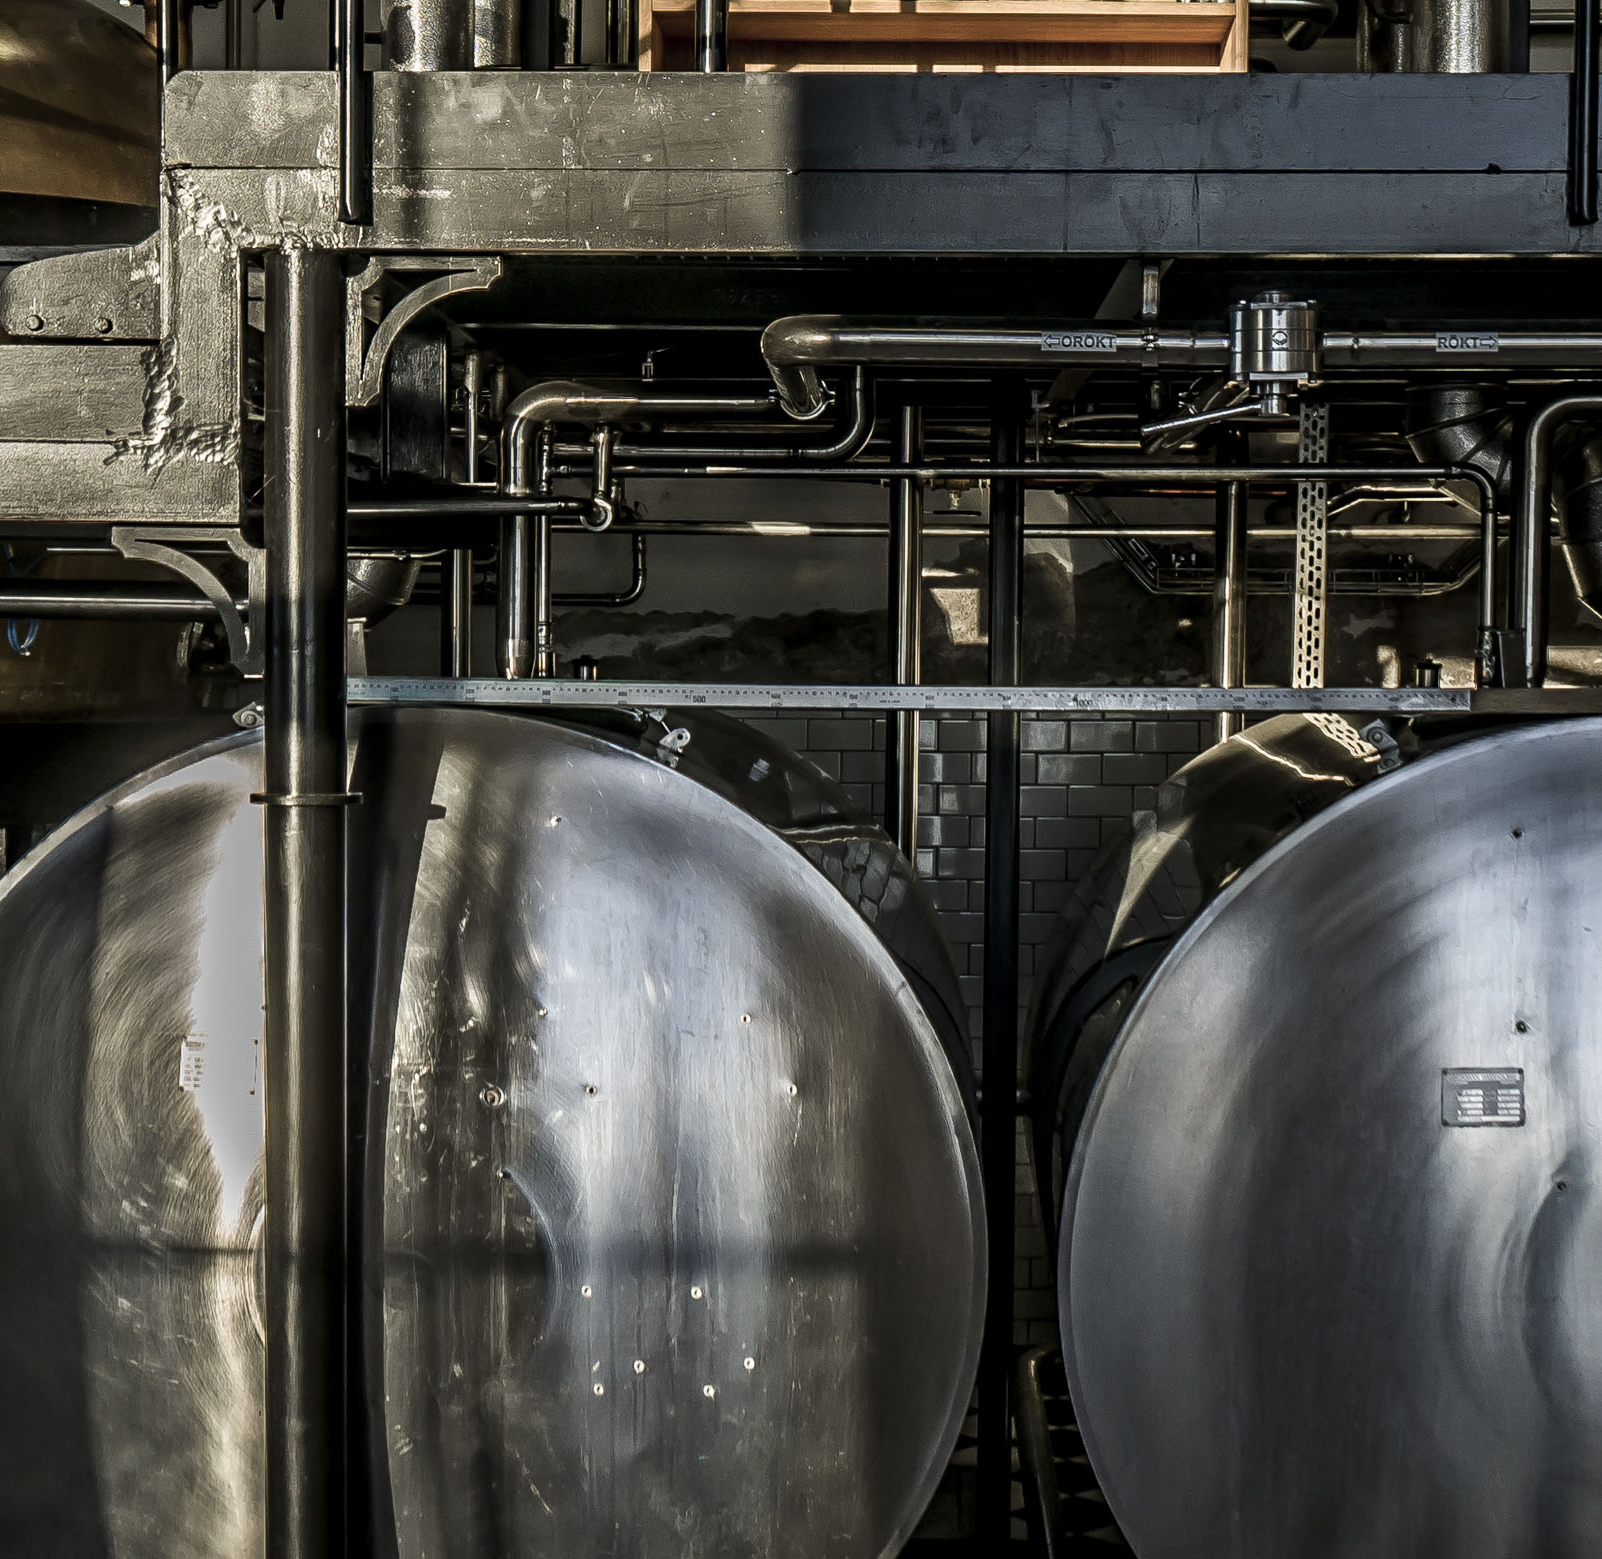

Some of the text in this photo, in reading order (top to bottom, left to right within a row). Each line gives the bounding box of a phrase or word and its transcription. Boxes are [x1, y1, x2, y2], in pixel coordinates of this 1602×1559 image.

[1061, 334, 1114, 348] ORÖKT
[1438, 334, 1479, 349] RÖKT
[692, 695, 707, 704] 500
[1076, 698, 1094, 707] 1000
